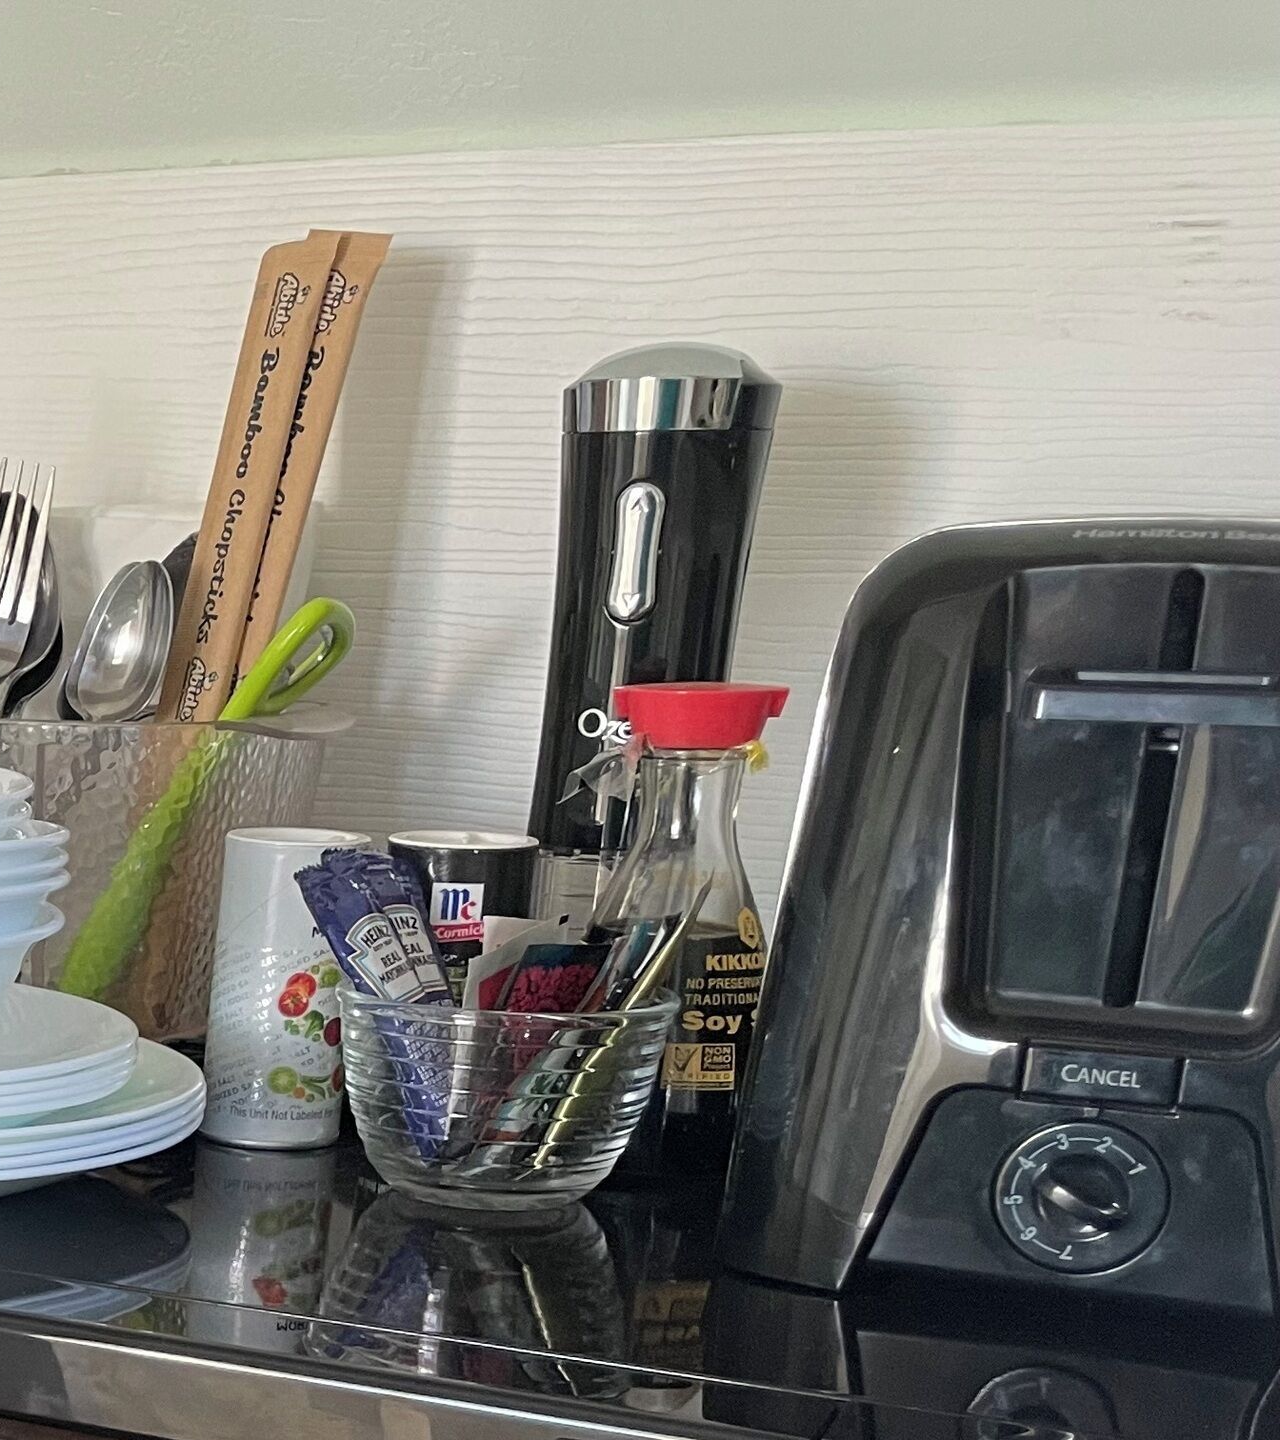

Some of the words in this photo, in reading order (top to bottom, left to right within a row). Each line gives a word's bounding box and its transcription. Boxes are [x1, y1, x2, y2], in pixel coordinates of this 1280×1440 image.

[235, 347, 280, 480] Bamboo
[195, 488, 246, 646] Chopsticks
[360, 924, 392, 949] HEINZ
[380, 950, 403, 969] REAL
[687, 977, 705, 990] NO
[681, 1010, 743, 1035] Soy
[703, 1046, 732, 1056] NON
[703, 1054, 732, 1064] GMO
[1060, 1063, 1142, 1089] CANCEL
[1056, 1133, 1070, 1150] 3
[1094, 1136, 1113, 1154] 2
[1018, 1156, 1037, 1170] 4
[1128, 1162, 1148, 1175] 1
[1003, 1194, 1024, 1205] 5
[1020, 1226, 1038, 1241] 6
[1058, 1245, 1073, 1260] 7
